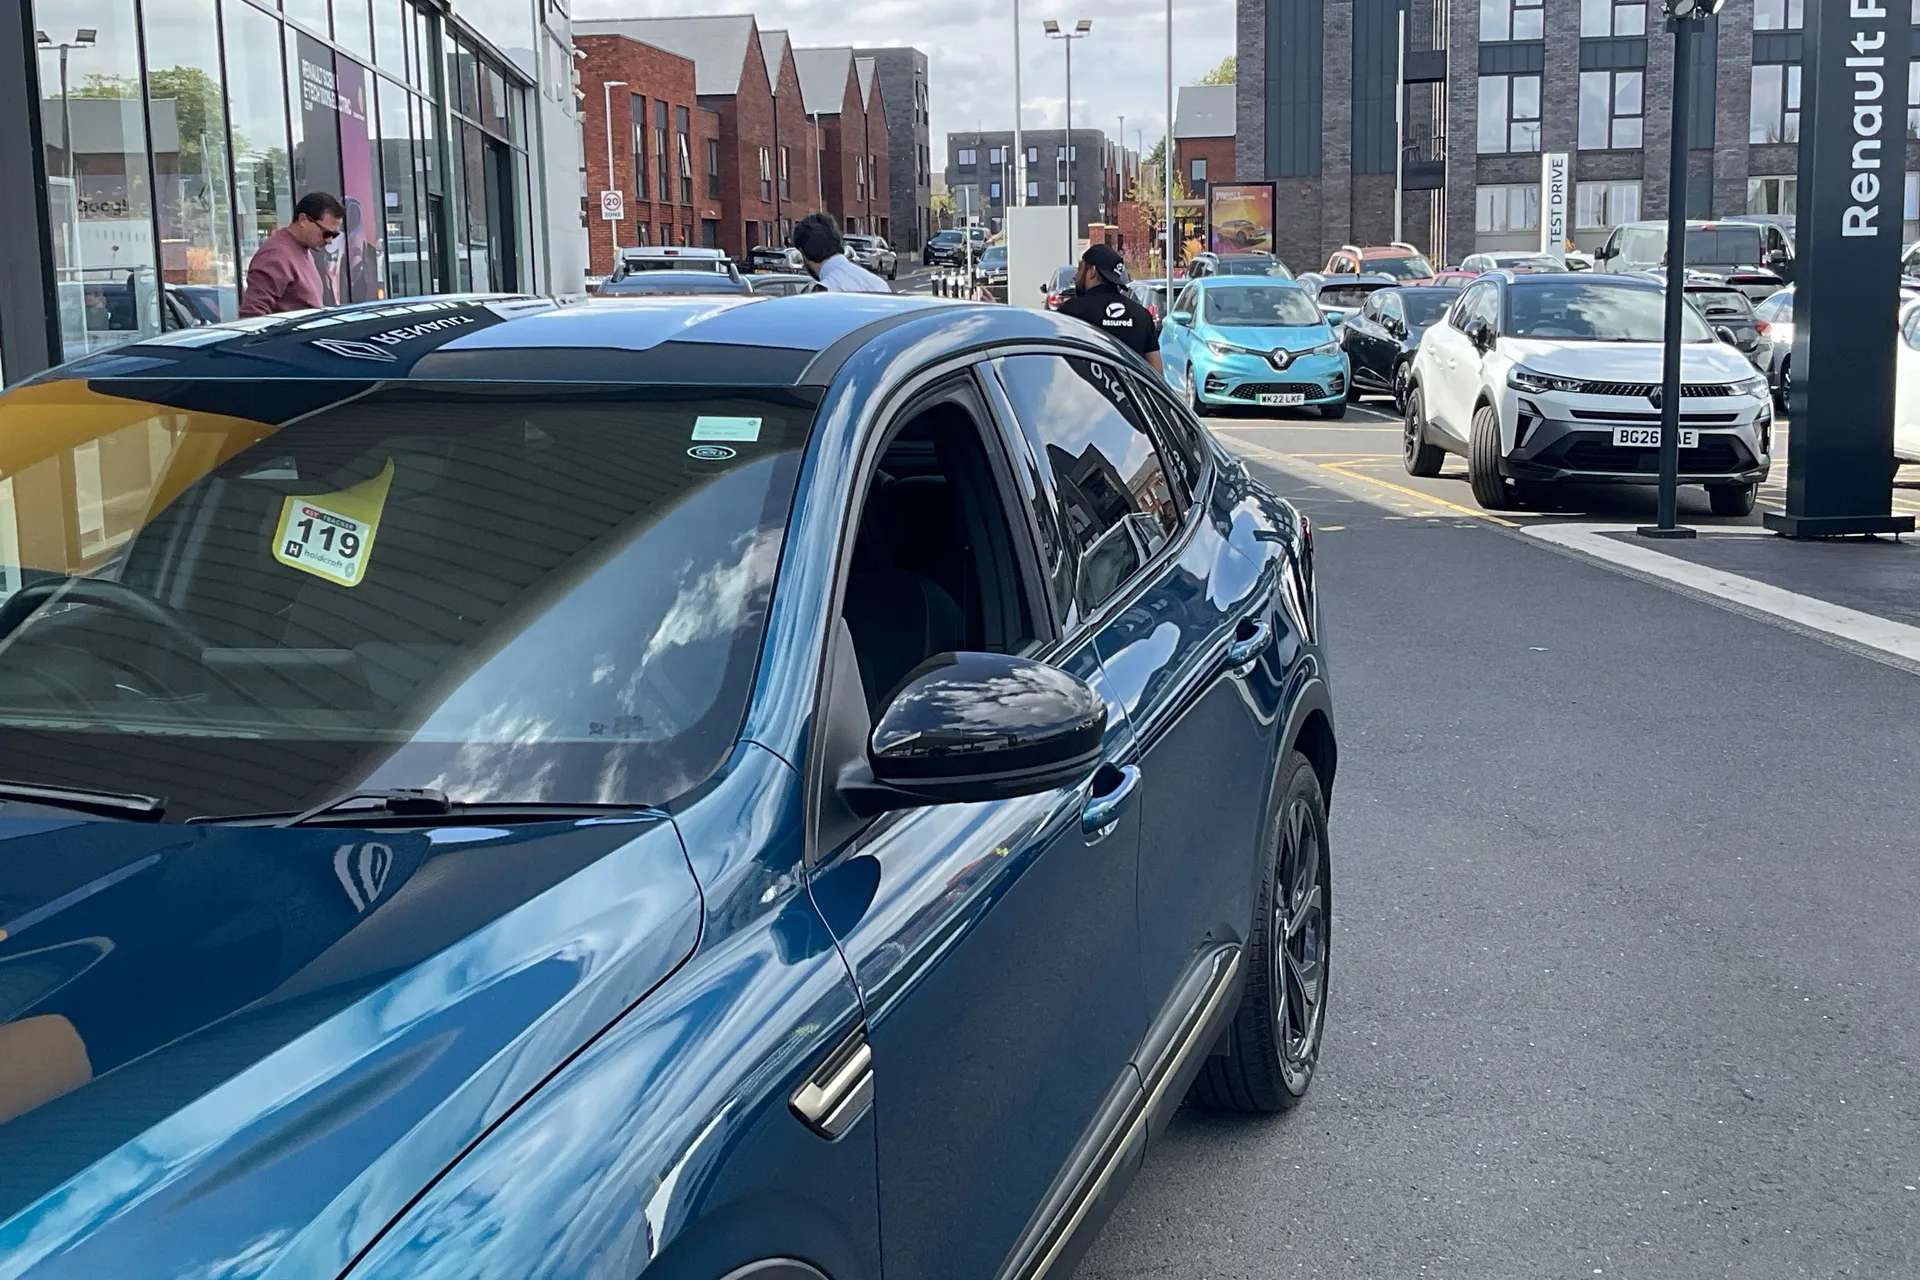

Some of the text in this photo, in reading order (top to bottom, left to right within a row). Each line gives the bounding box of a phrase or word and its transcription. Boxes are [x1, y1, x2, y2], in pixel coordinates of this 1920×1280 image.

[1842, 31, 1885, 237] Renault
[1550, 158, 1564, 247] TEST DRIVE
[1102, 318, 1133, 327] assured
[1619, 430, 1660, 444] BG26
[322, 514, 354, 529] TRACKER
[297, 518, 360, 559] 119
